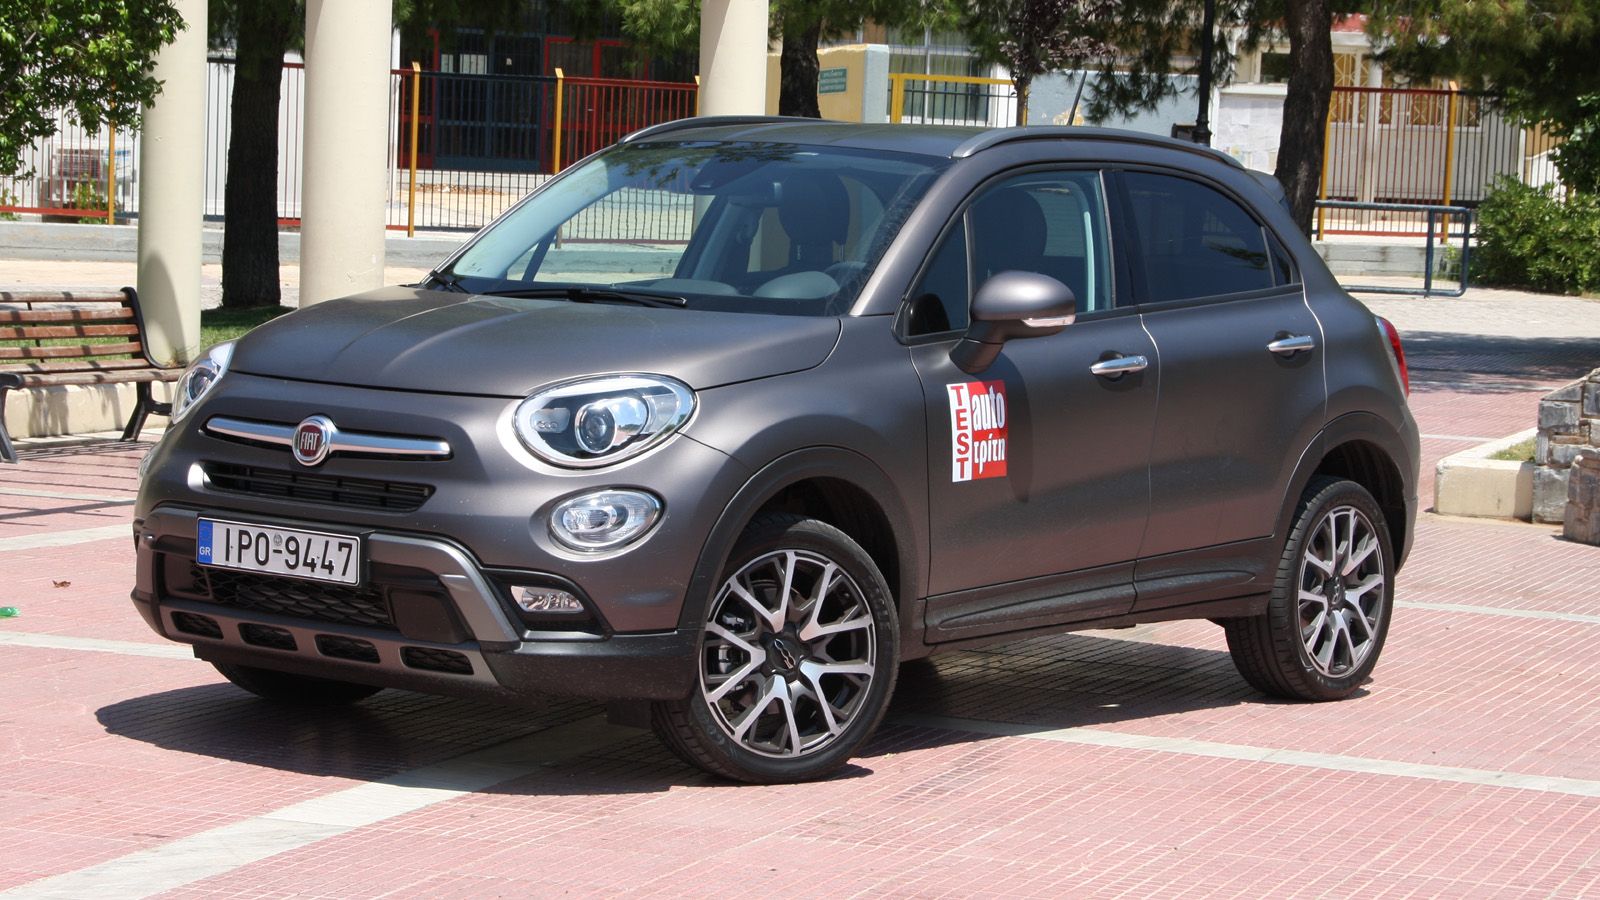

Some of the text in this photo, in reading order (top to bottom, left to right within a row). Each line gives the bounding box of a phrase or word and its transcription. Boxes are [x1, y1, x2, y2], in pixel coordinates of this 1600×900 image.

[971, 385, 1006, 431] auto
[300, 431, 320, 451] FIAT
[950, 385, 970, 479] TEST
[199, 546, 211, 556] GR
